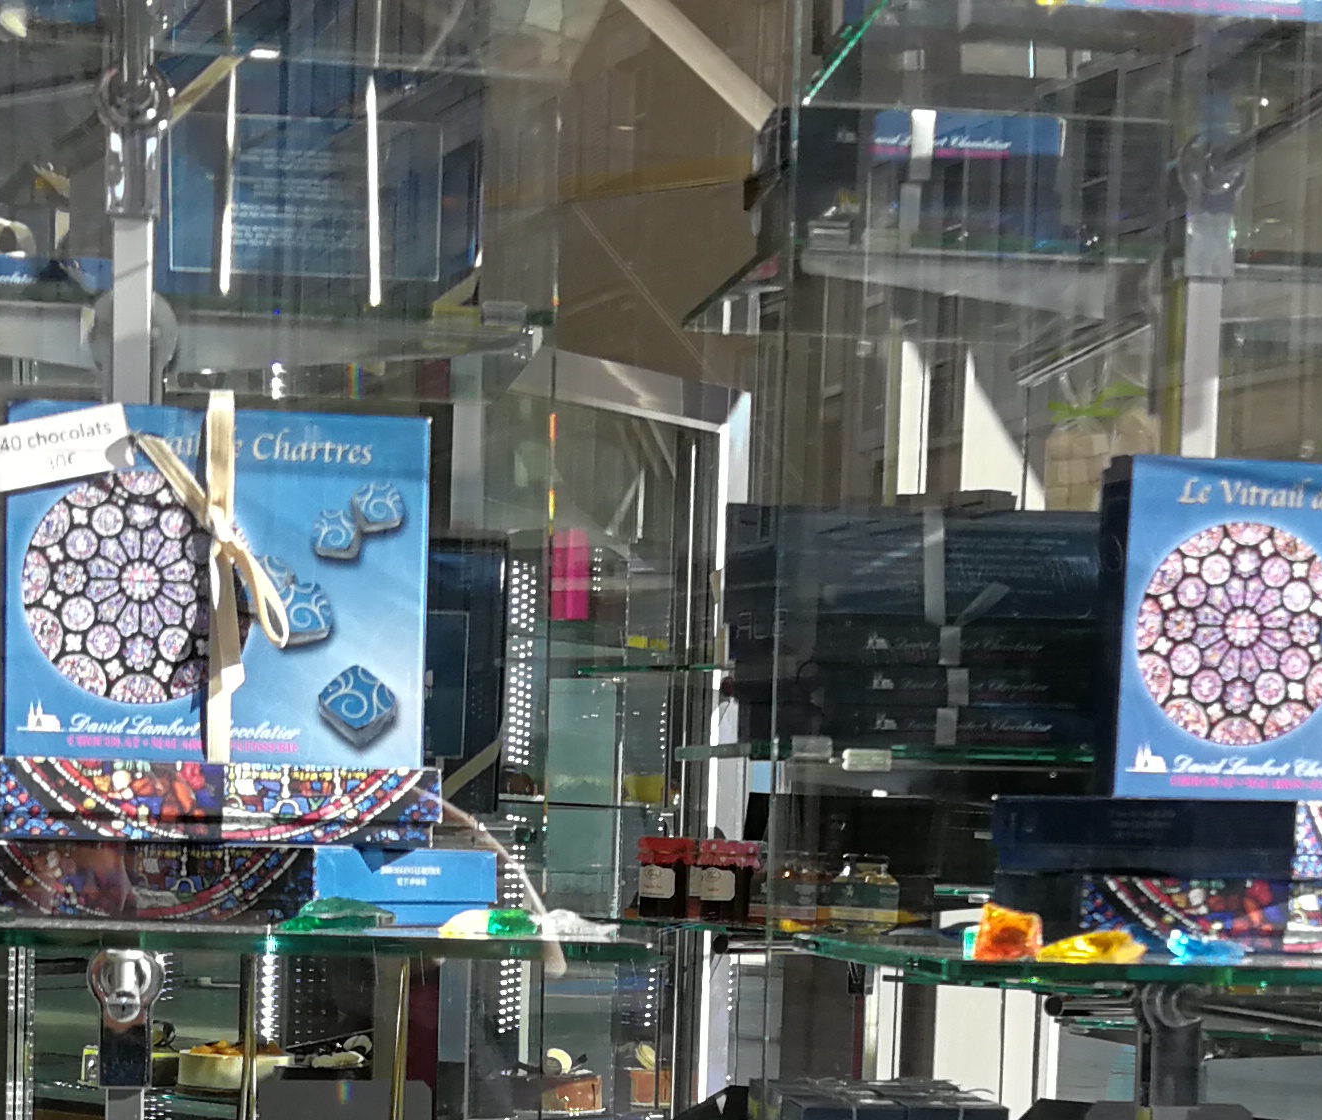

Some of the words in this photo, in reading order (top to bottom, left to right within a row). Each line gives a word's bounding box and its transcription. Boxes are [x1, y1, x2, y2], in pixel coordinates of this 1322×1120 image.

[0, 434, 22, 452] 40
[27, 420, 112, 449] chocolats
[252, 427, 373, 465] Chartres
[1177, 476, 1212, 505] Le
[1219, 477, 1313, 509] Vitrail
[69, 713, 127, 734] David
[125, 716, 199, 737] Lambert
[1173, 754, 1228, 774] David
[1223, 756, 1291, 777] Lambert
